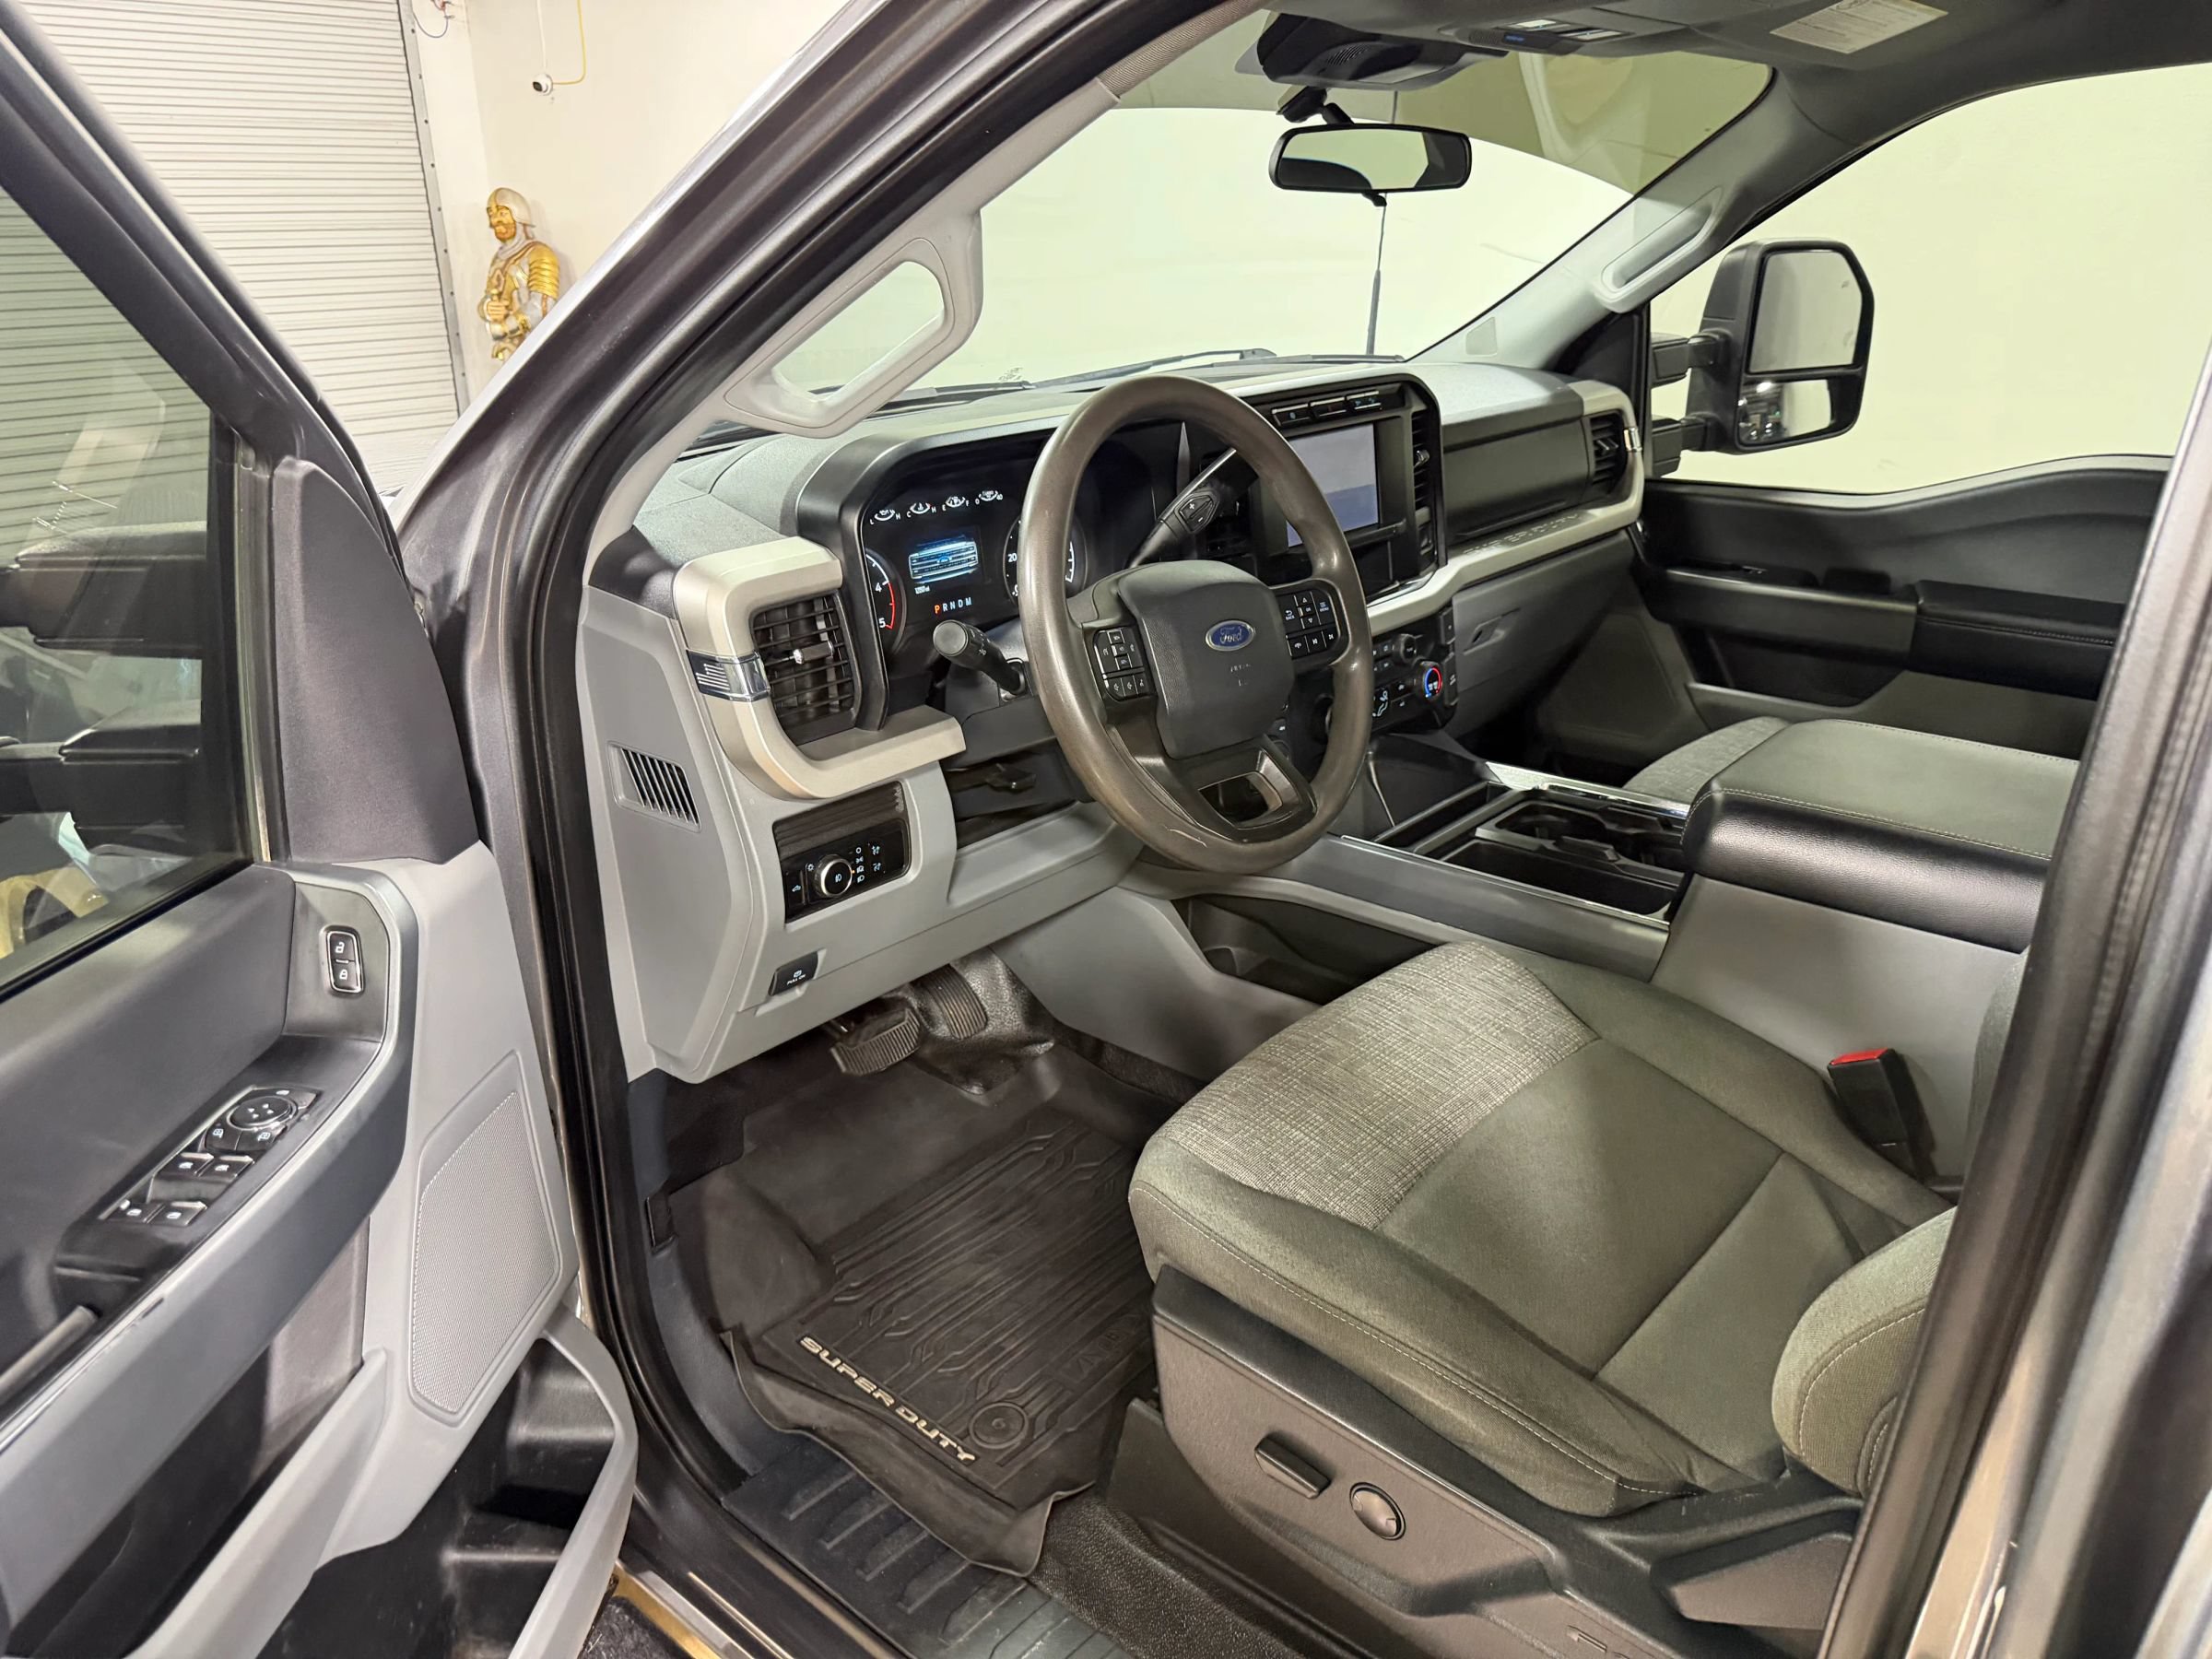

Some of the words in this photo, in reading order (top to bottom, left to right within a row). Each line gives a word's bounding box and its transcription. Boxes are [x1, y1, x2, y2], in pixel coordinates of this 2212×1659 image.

[875, 582, 883, 593] 4
[878, 618, 886, 629] 5
[1219, 627, 1242, 644] Ford
[800, 1336, 895, 1407] SUPER
[895, 1405, 975, 1461] DUTY
